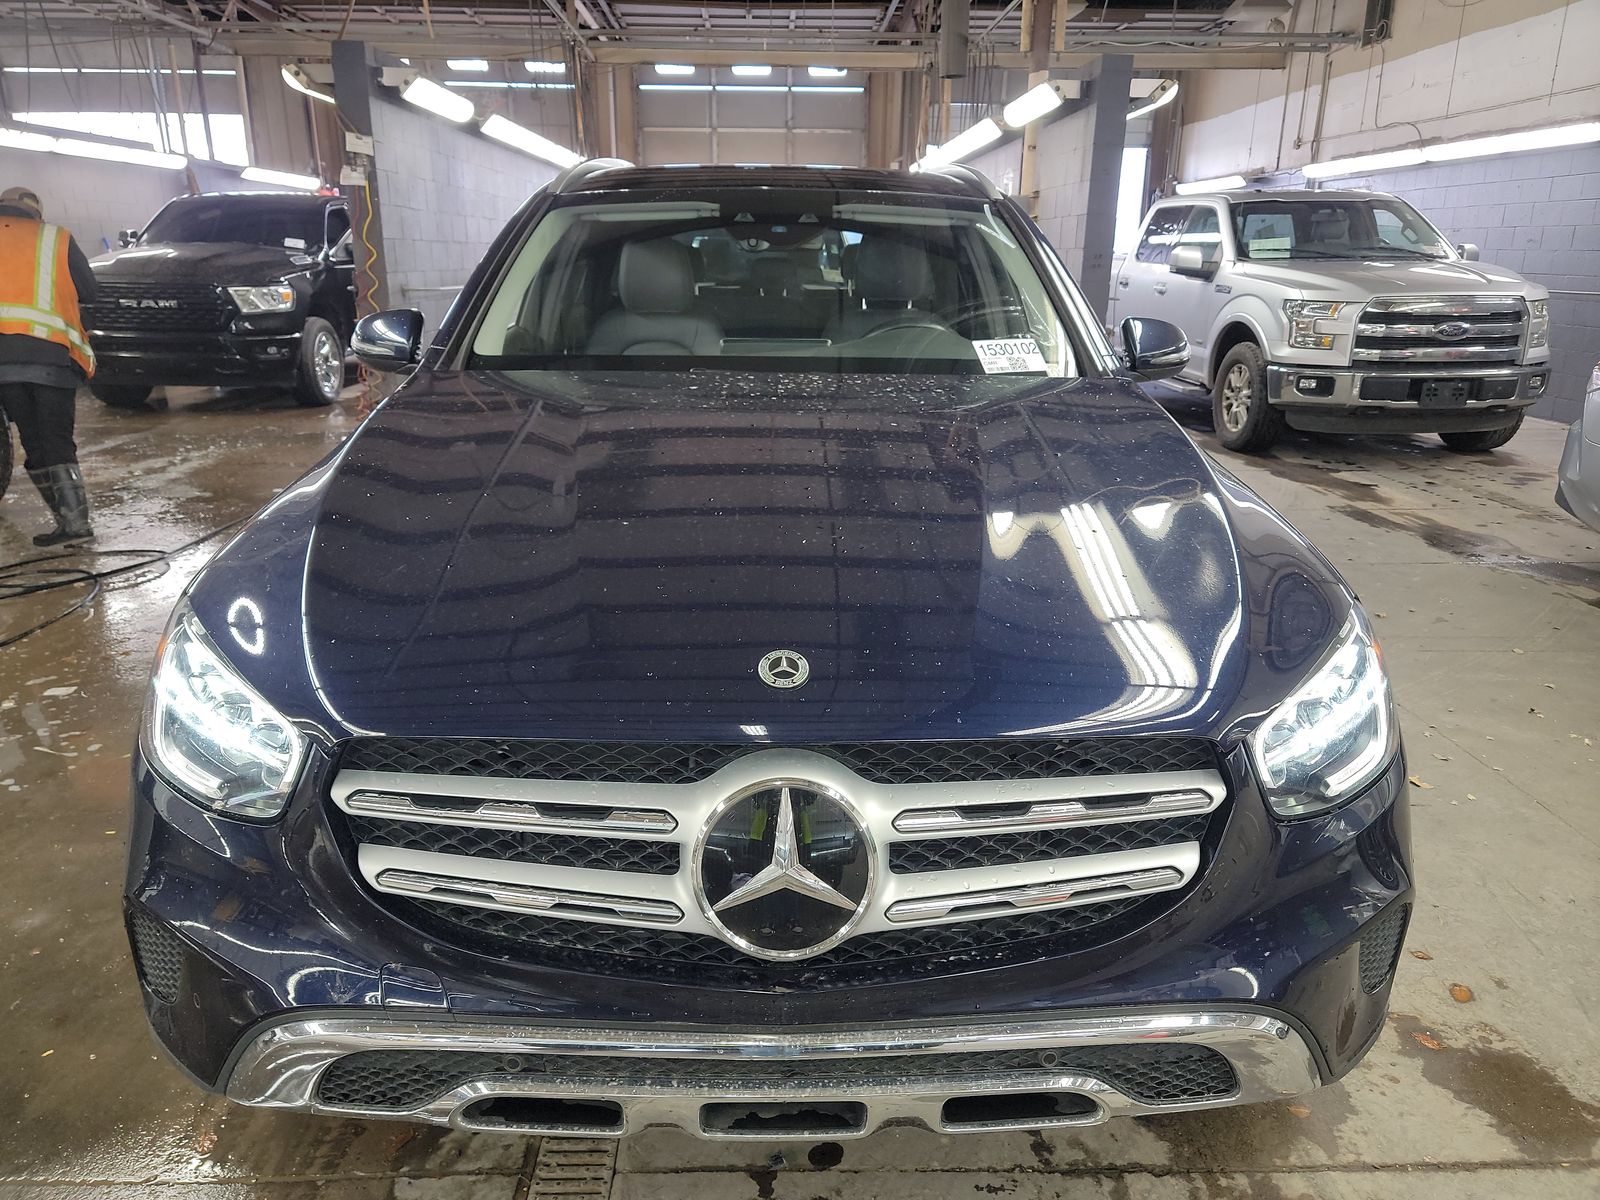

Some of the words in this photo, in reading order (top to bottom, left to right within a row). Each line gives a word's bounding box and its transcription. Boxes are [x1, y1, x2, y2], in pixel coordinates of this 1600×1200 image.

[119, 298, 178, 309] RAM
[1442, 325, 1464, 336] Ford
[978, 342, 1040, 356] 1530102
